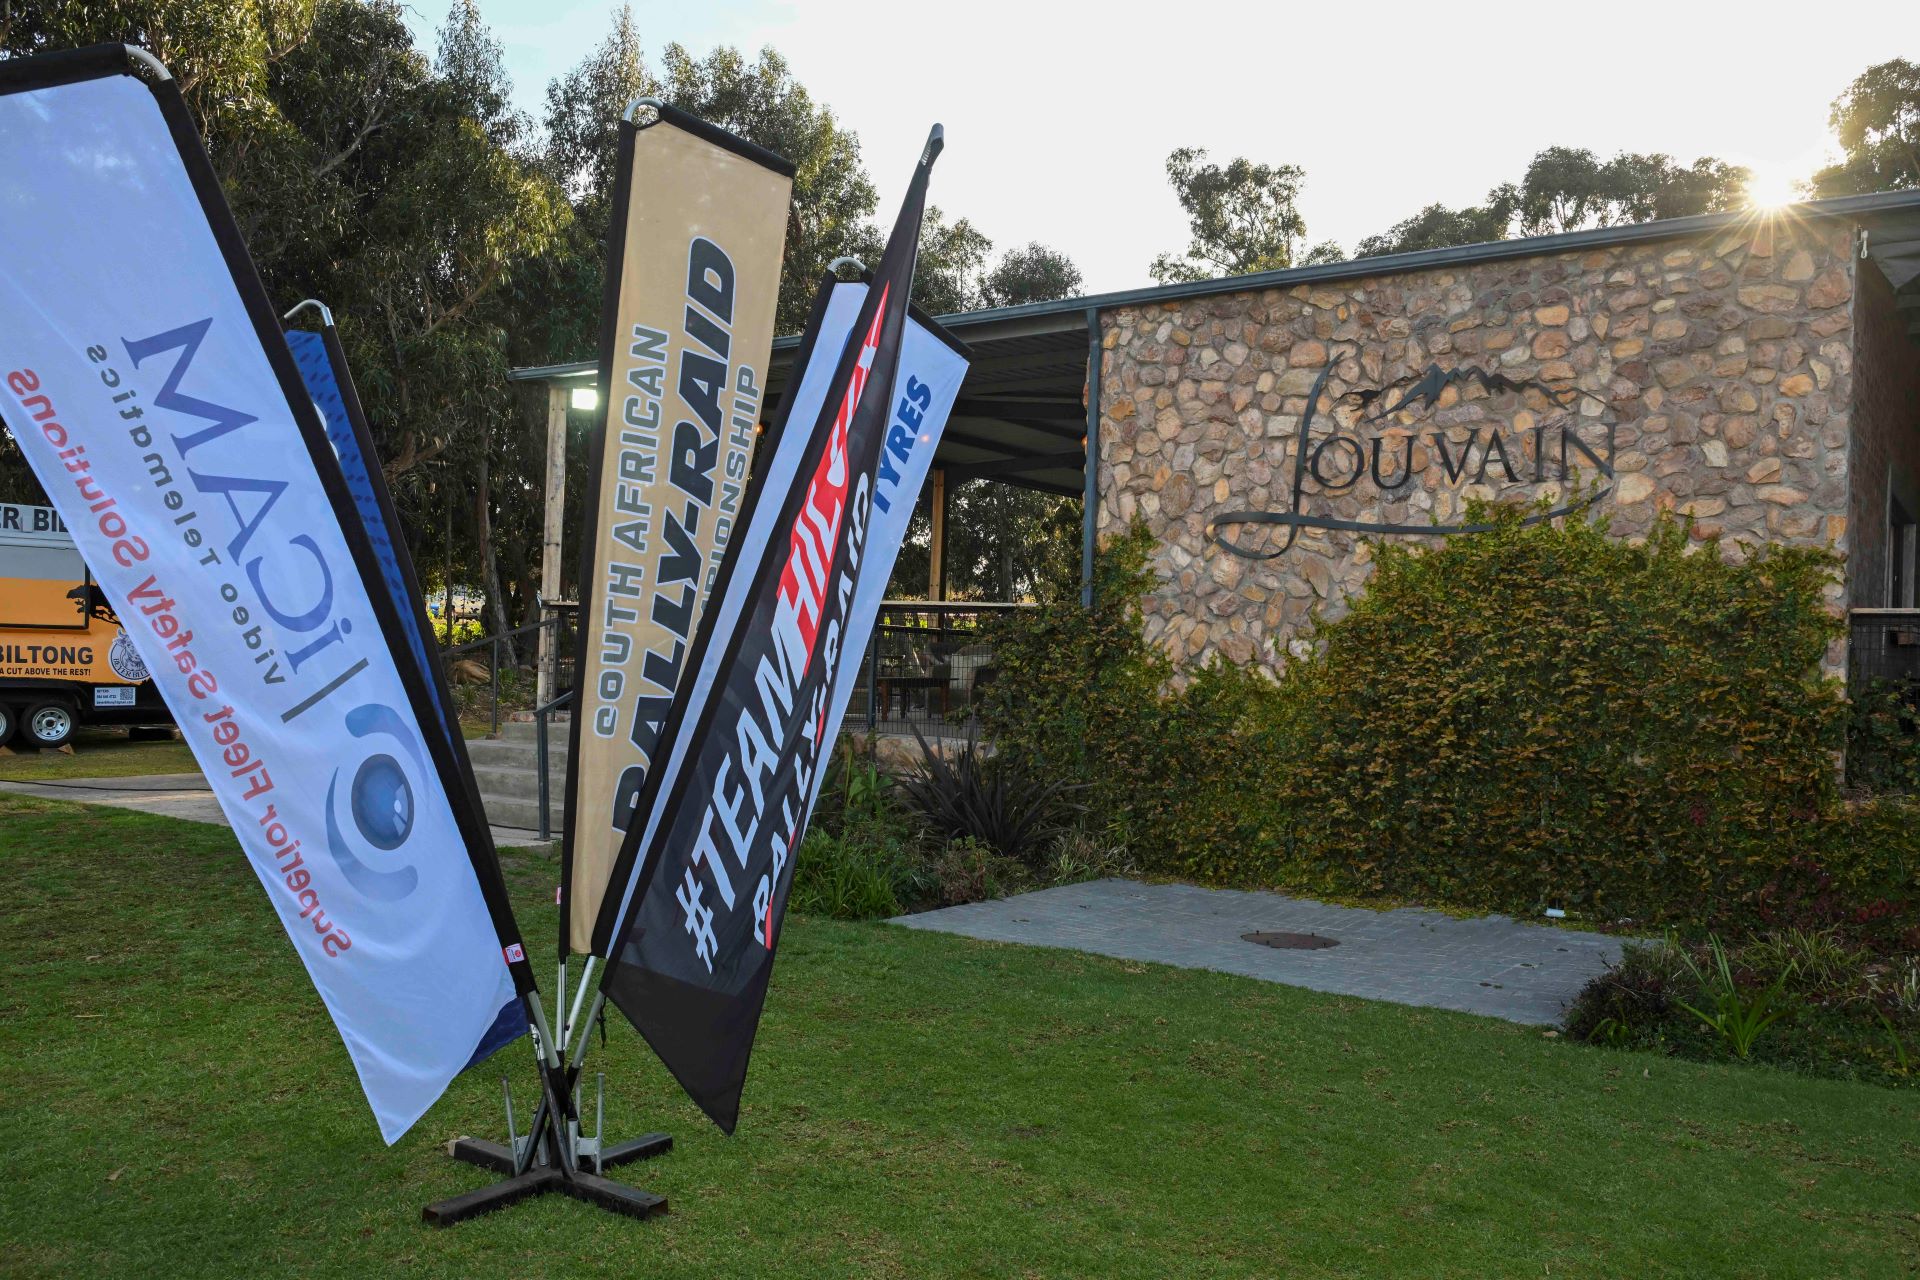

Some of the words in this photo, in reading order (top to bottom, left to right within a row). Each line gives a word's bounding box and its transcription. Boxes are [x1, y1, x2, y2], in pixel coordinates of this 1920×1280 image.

[613, 324, 670, 555] AFRICAN
[695, 364, 760, 631] PIONSHIP
[873, 374, 932, 514] TYRES
[69, 668, 91, 676] REST!
